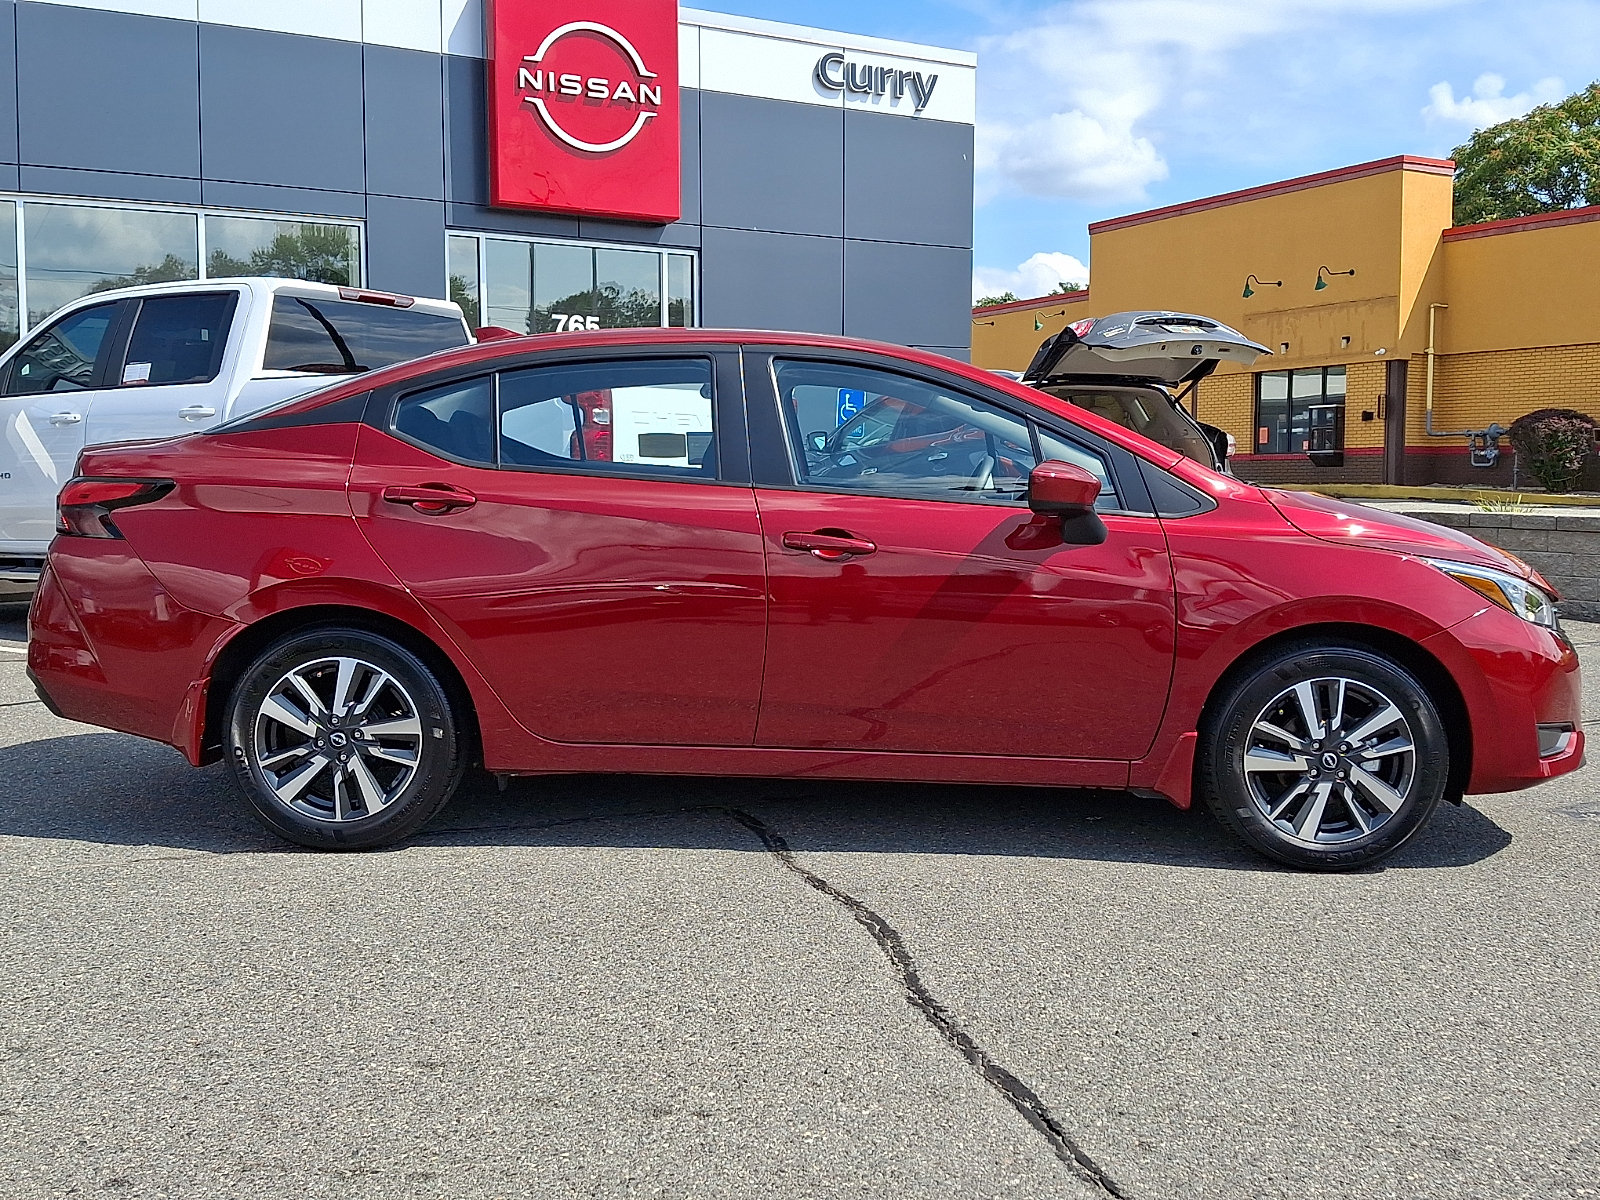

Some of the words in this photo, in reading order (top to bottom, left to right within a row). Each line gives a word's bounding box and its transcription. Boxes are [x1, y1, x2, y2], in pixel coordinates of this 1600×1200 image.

[518, 67, 661, 105] NISSAN
[816, 52, 939, 110] Curry
[551, 313, 600, 332] 765
